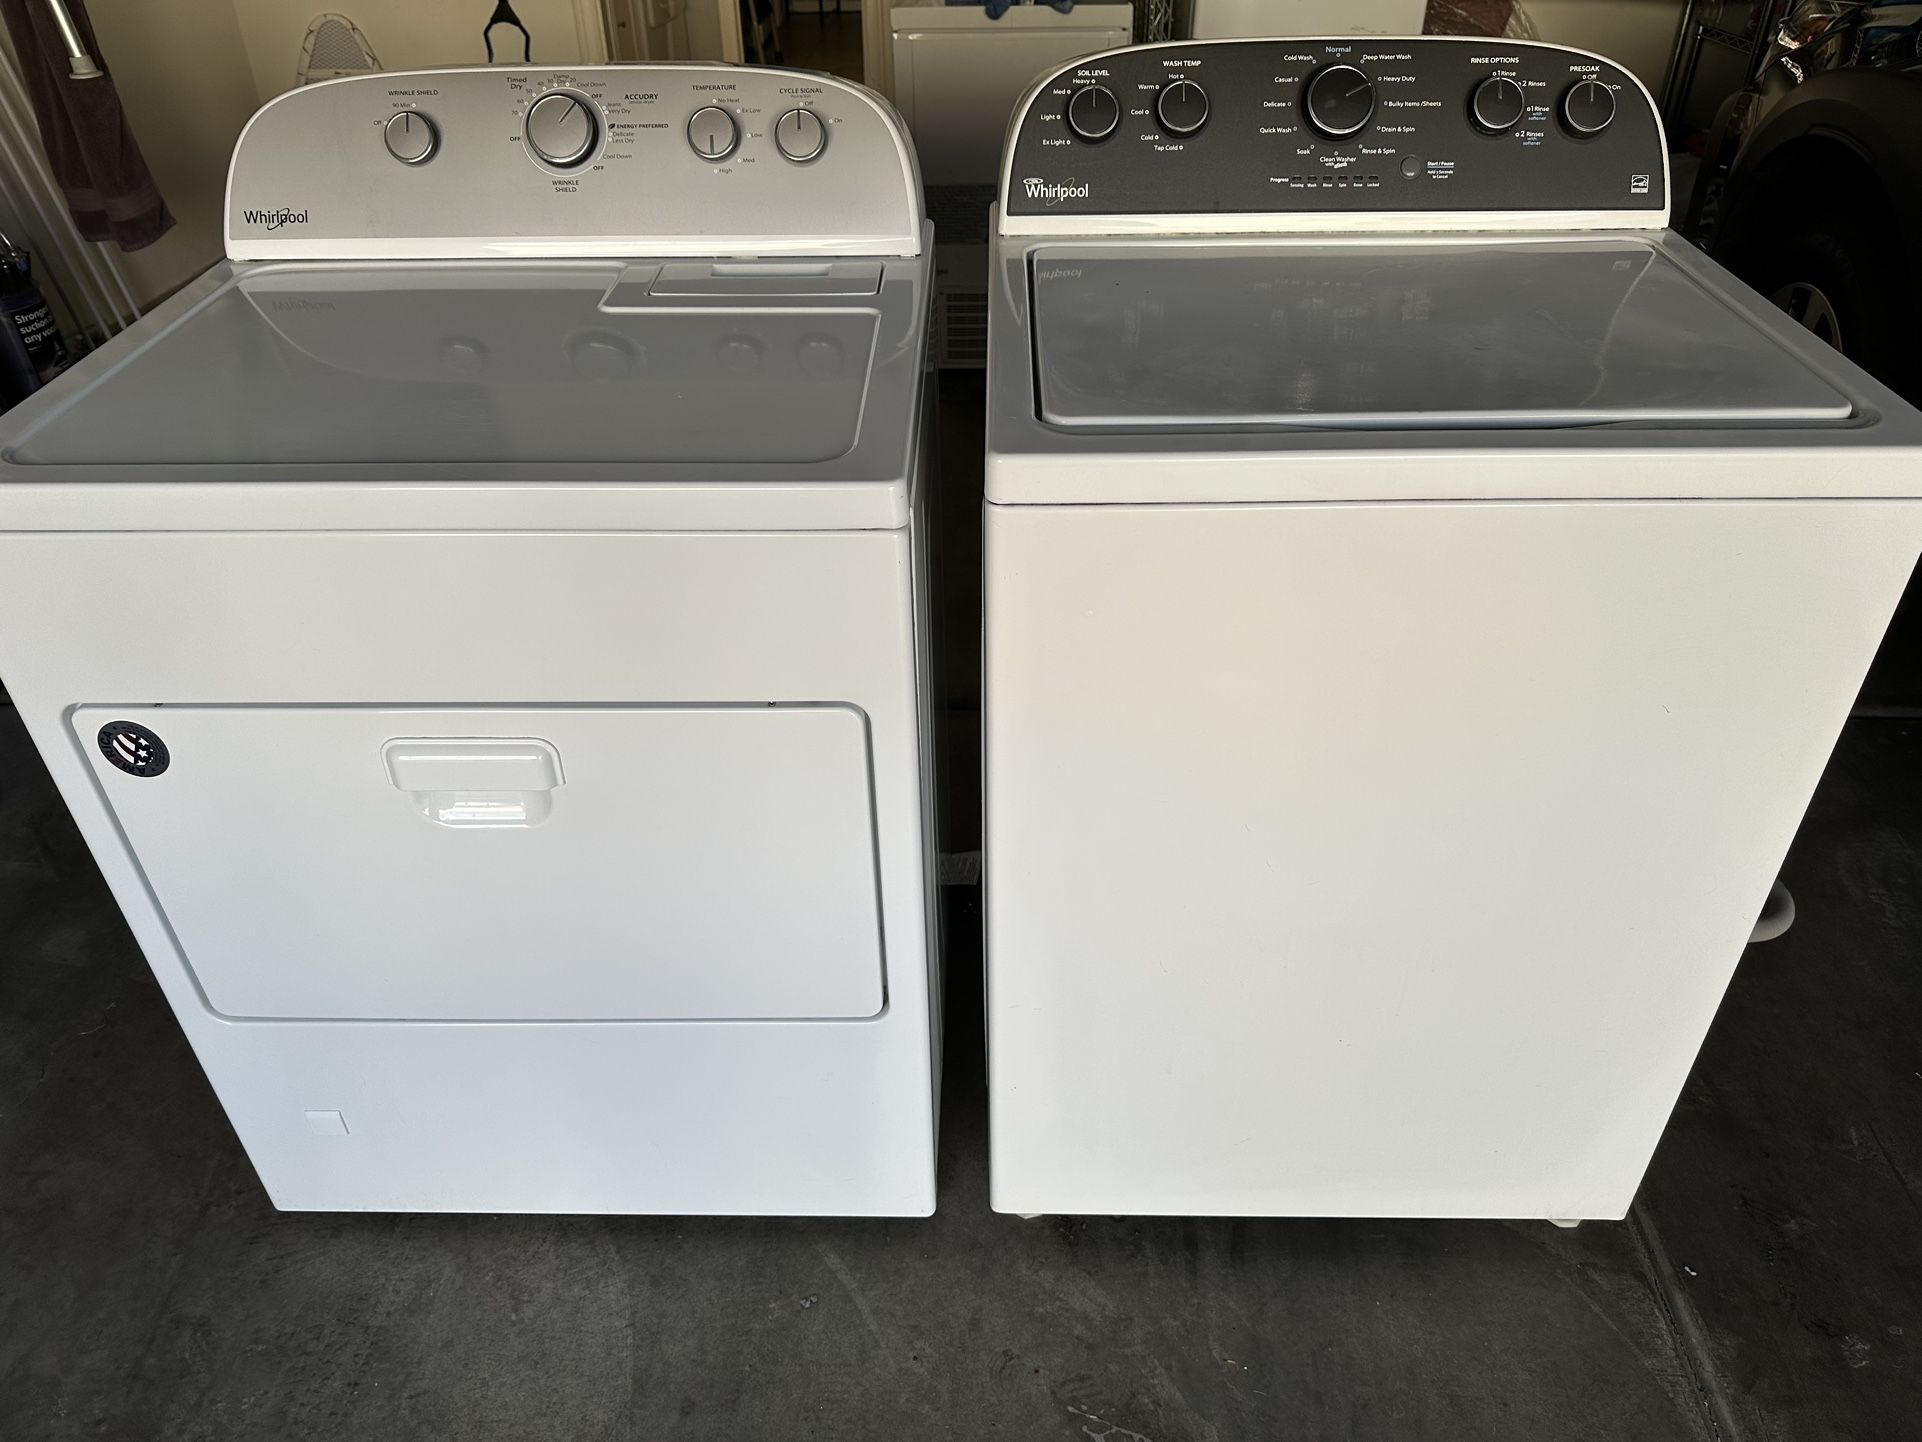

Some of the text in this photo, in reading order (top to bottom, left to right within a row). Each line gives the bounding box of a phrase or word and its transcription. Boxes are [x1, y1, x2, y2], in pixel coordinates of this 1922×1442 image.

[1025, 183, 1089, 202] Whirlpool
[244, 208, 308, 230] Whirlpool
[14, 306, 48, 324] Stronge
[24, 333, 42, 344] any
